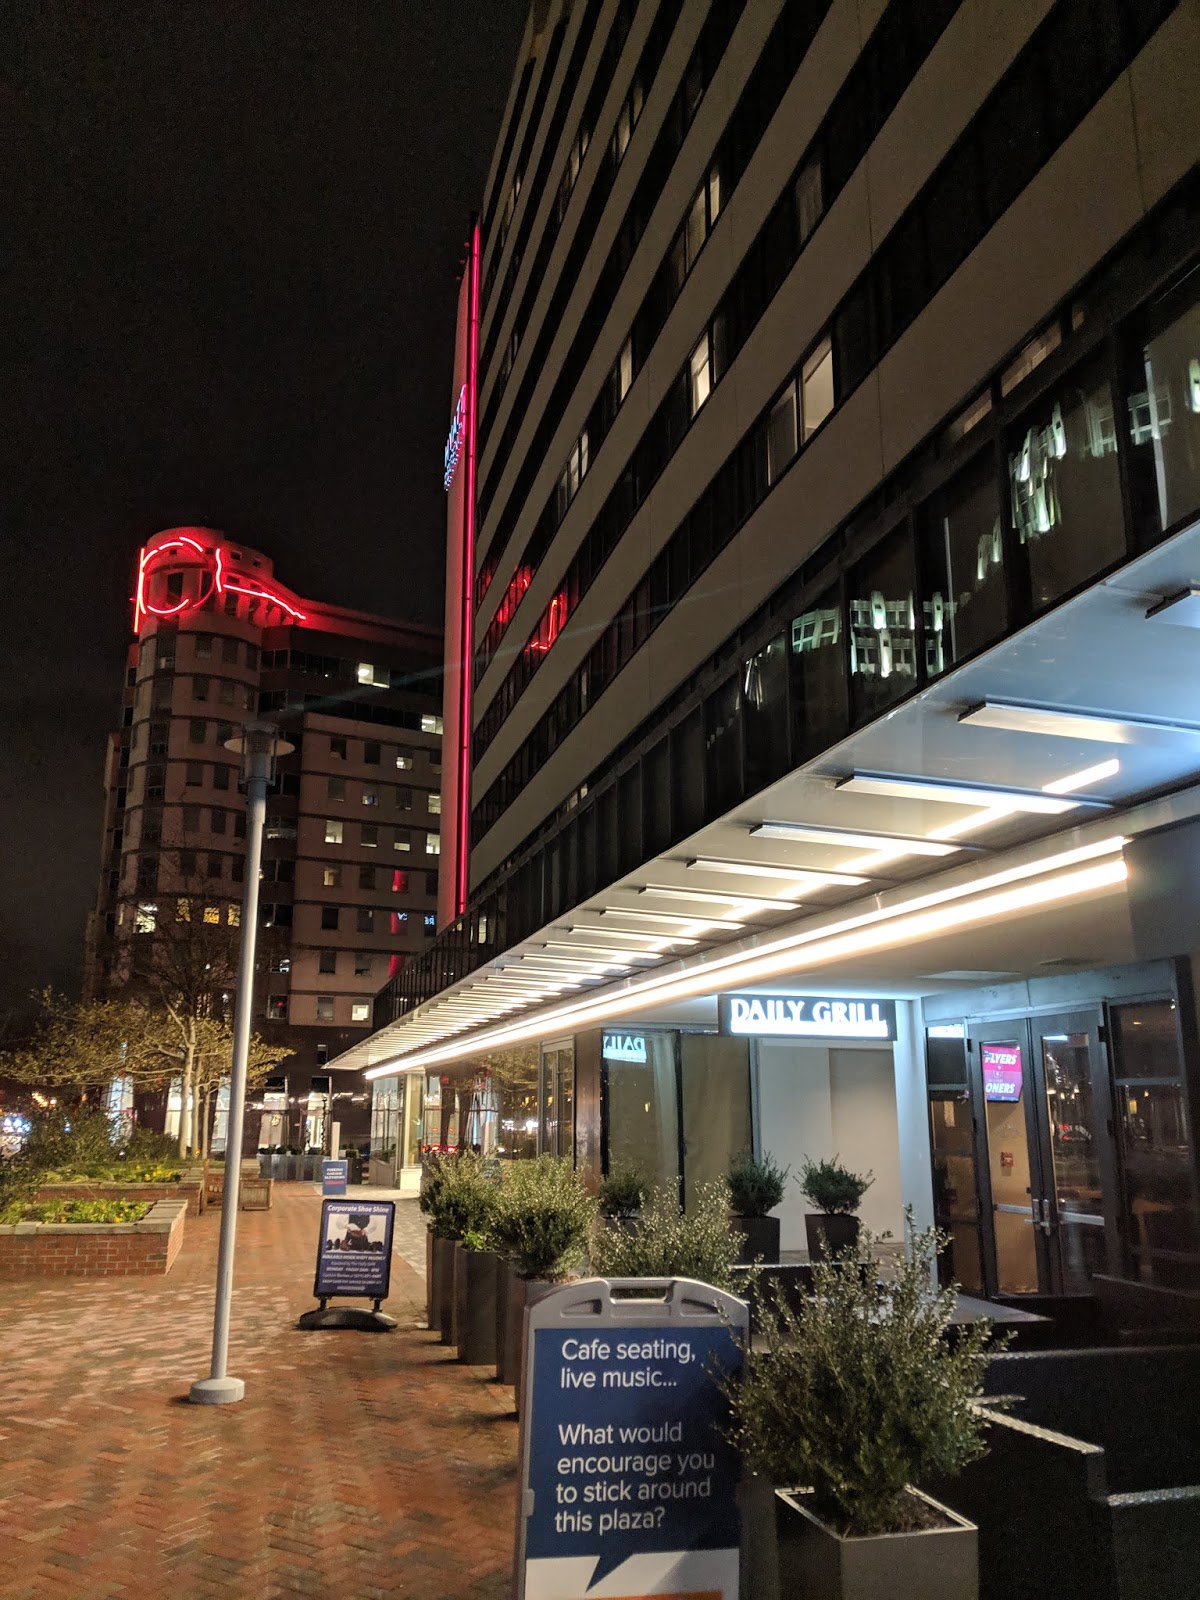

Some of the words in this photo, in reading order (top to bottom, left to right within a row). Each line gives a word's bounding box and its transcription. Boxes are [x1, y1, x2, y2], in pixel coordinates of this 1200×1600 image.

[731, 999, 805, 1023] DAILY
[812, 1002, 887, 1024] GRILL
[985, 1052, 1018, 1065] FLYERS
[327, 1204, 357, 1213] Corporate
[358, 1205, 373, 1213] Shoe
[561, 1338, 611, 1361] Cafe
[616, 1339, 696, 1364] seating,
[560, 1367, 597, 1389] live
[602, 1367, 678, 1388] music...
[558, 1423, 614, 1446] What
[619, 1421, 683, 1444] would
[557, 1454, 672, 1477] encourage
[677, 1453, 715, 1476] you
[555, 1484, 578, 1504] to
[583, 1479, 632, 1503] stick
[637, 1476, 712, 1499] around
[555, 1509, 593, 1534] this
[599, 1506, 666, 1536] plaza?
